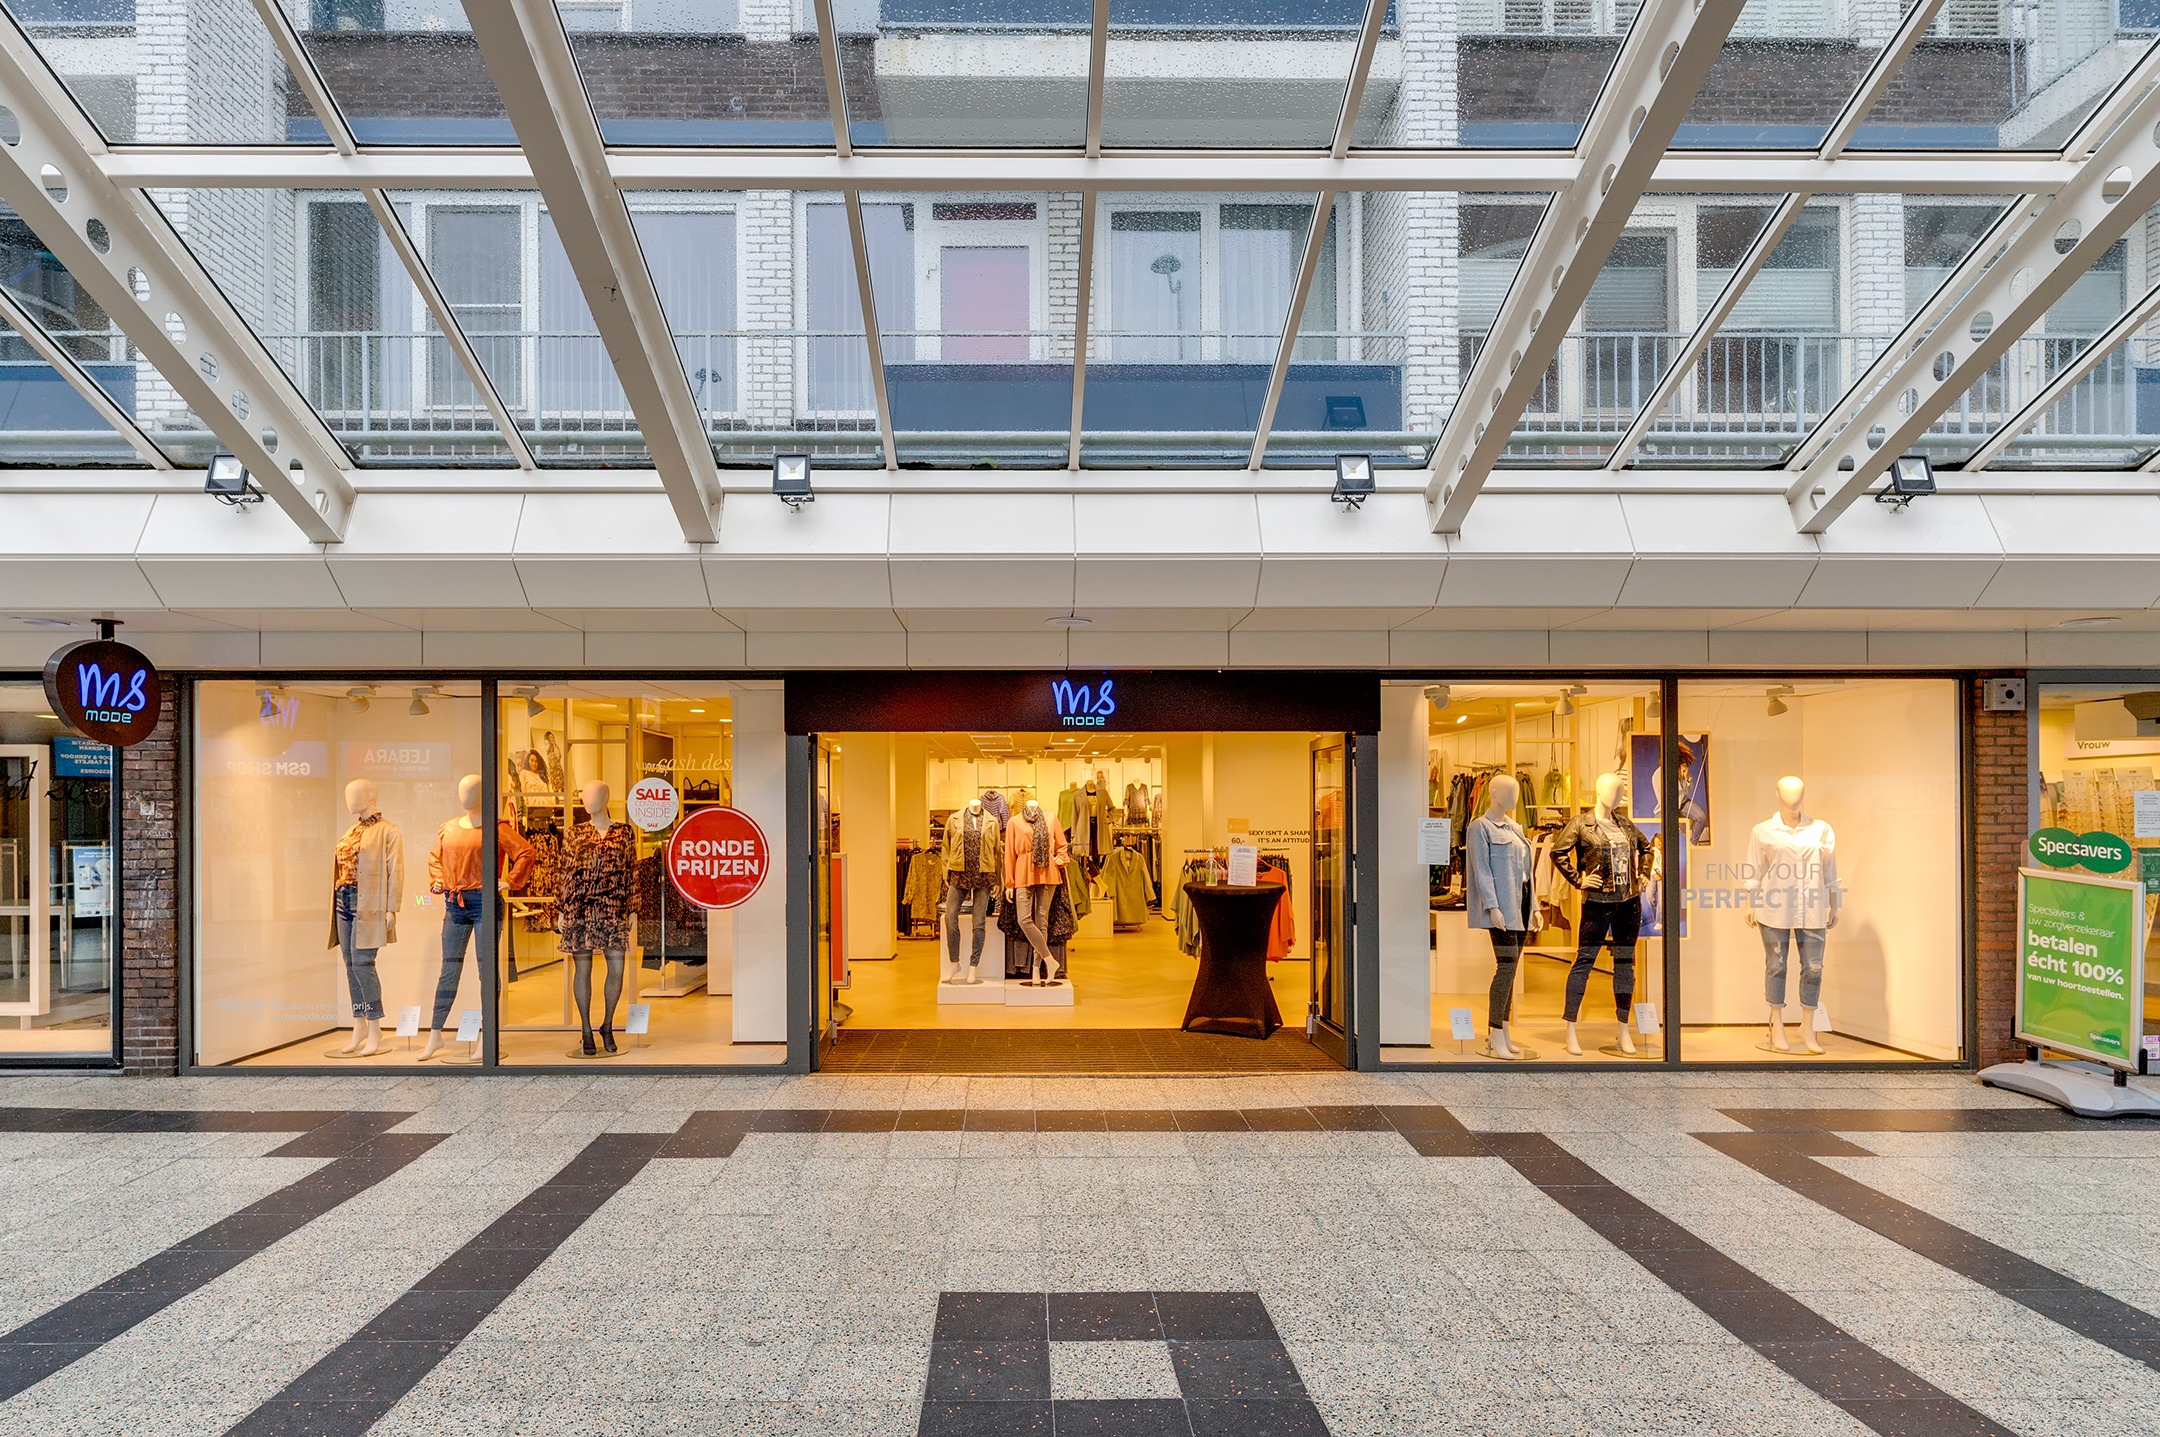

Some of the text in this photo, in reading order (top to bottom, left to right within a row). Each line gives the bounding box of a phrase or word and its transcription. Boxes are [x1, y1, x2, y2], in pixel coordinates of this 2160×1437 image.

[2077, 741, 2111, 750] Vrouw
[658, 753, 696, 770] cash
[701, 753, 732, 770] des
[636, 788, 671, 801] SALE
[635, 807, 671, 818] INSIDE
[681, 840, 755, 856] RONDE
[2038, 836, 2122, 861] Specsavers
[677, 859, 759, 880] PRIJZEN
[1705, 863, 1823, 880] FIND YOUR
[1681, 887, 1848, 909] PERFECT FIT
[2028, 903, 2085, 921] Specsavers &
[2028, 918, 2115, 939] uw zorgverzekeraar
[2028, 930, 2098, 958] betalen
[2027, 951, 2125, 986] écht 100%
[2027, 973, 2125, 1000] van uw hoortoestellen.
[352, 1000, 374, 1012] prijs.
[2089, 1032, 2121, 1046] Specsavers
